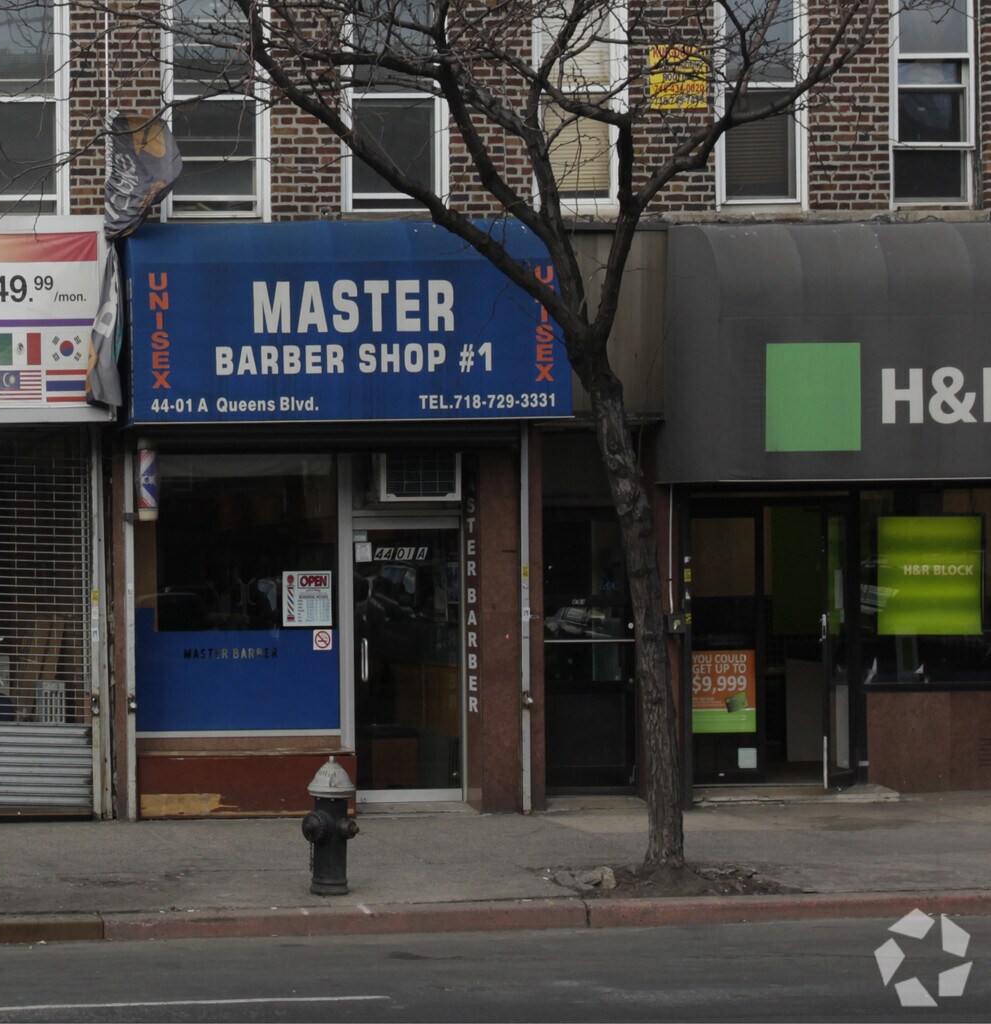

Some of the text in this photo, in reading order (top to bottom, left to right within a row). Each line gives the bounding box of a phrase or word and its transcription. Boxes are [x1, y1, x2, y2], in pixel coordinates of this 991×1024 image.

[53, 290, 87, 303] /mon.
[252, 279, 456, 334] MASTER
[148, 272, 171, 389] UNISEX
[534, 265, 554, 382] UISEX
[215, 342, 494, 377] BARBER SHOP #1
[151, 395, 319, 414] 44-01 A Queens Blvd.
[881, 367, 991, 424] H&
[904, 564, 974, 575] H&R BLOCK
[300, 575, 327, 587] OPEN
[467, 588, 478, 713] BARBER
[692, 654, 747, 664] YOU COULD
[692, 664, 747, 674] GET UP TO
[692, 674, 747, 694] $9,999
